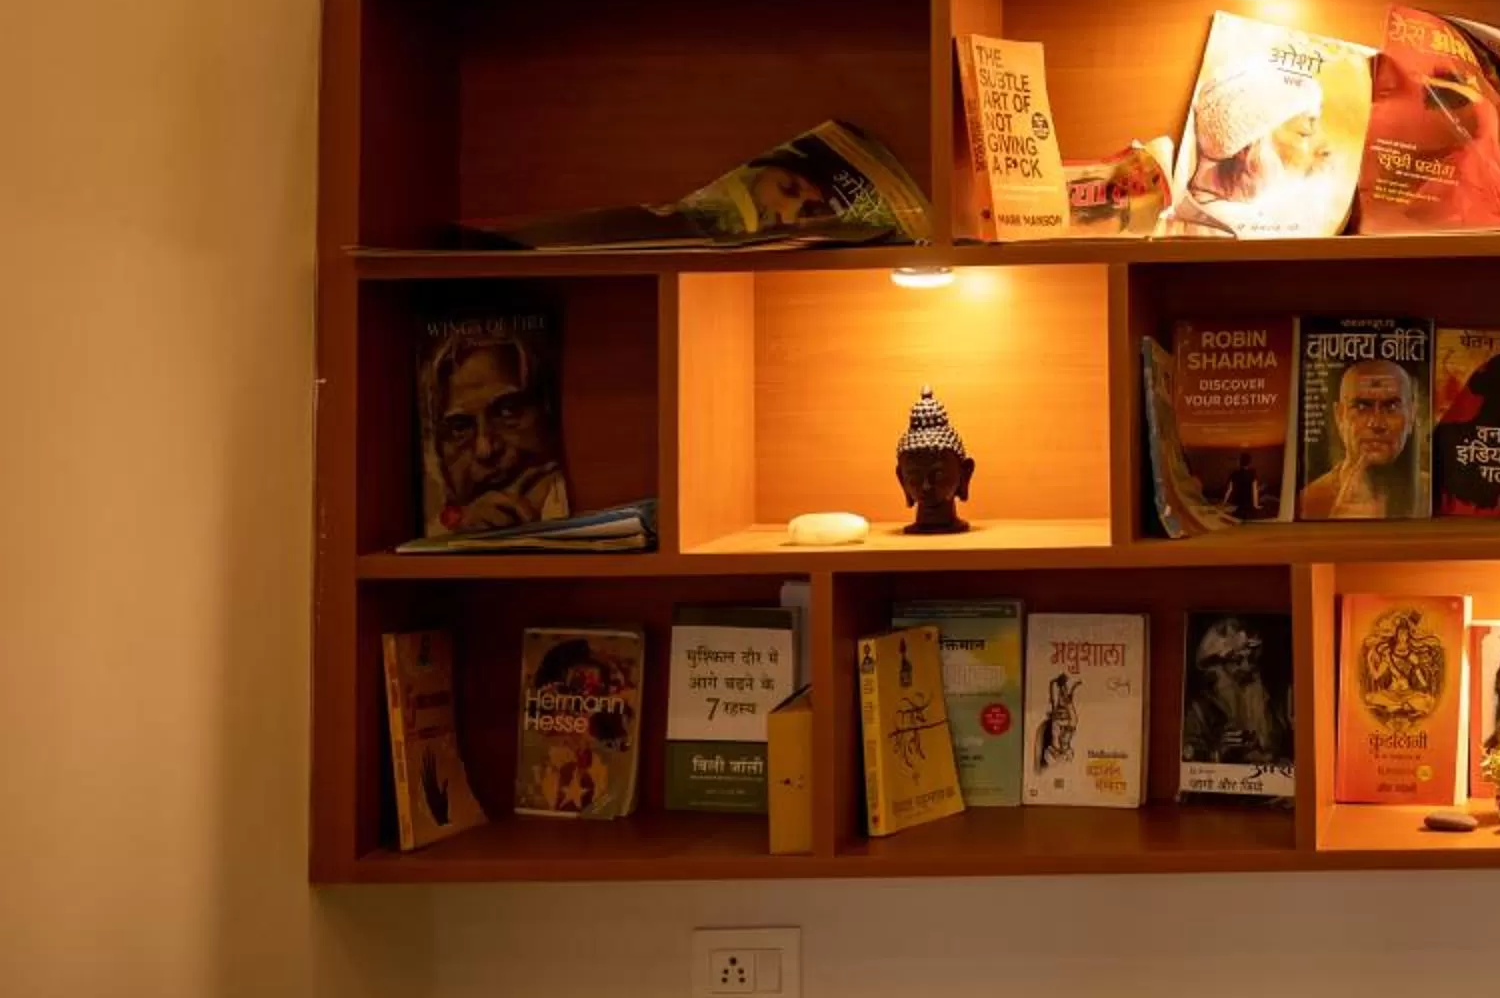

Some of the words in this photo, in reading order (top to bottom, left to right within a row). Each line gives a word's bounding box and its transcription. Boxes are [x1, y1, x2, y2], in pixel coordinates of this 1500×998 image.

[976, 45, 1002, 68] THE
[1267, 43, 1324, 74] ओशो
[979, 68, 1031, 92] SUBTLE
[984, 91, 1008, 110] ART
[1012, 94, 1032, 113] OF
[985, 113, 1013, 133] NOT
[987, 133, 1038, 156] GIVING
[992, 157, 1003, 175] A
[1200, 330, 1268, 349] ROBIN
[1306, 333, 1378, 362] चाणक्य
[1187, 351, 1278, 370] SHARMA
[1199, 378, 1266, 392] DISCOVER
[1184, 394, 1221, 408] YOUR
[1223, 393, 1279, 407] DESTINY
[940, 634, 985, 650] क्तिमान
[1050, 640, 1126, 675] मधुशाला
[688, 670, 718, 690] आगे
[525, 688, 624, 715] Hermann
[705, 697, 720, 721] 7
[524, 709, 588, 734] Hesse
